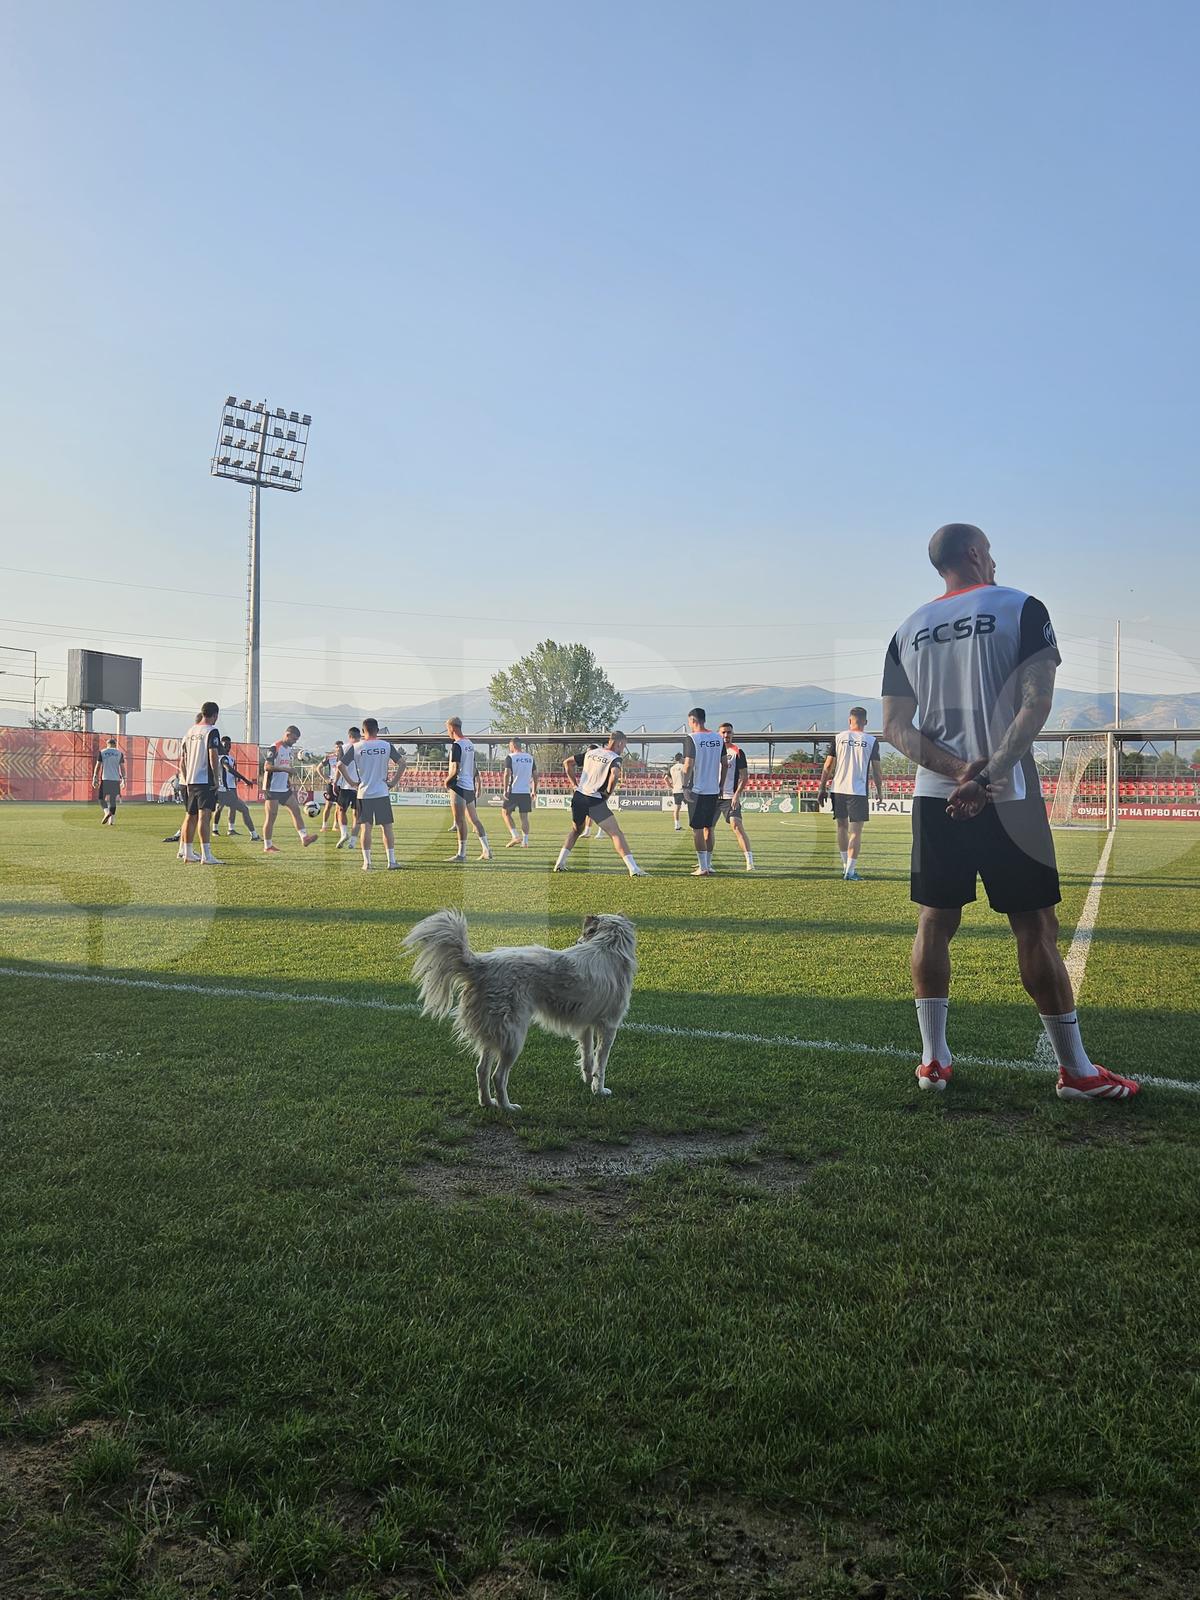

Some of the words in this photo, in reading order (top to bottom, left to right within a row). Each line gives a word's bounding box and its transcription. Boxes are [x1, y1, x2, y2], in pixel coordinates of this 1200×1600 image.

[912, 614, 996, 651] FCSB
[360, 748, 386, 756] FCSB
[871, 801, 911, 813] IRAL
[1130, 808, 1143, 816] НА
[1144, 808, 1170, 817] ПРВО
[1172, 809, 1200, 817] МЕСТ
